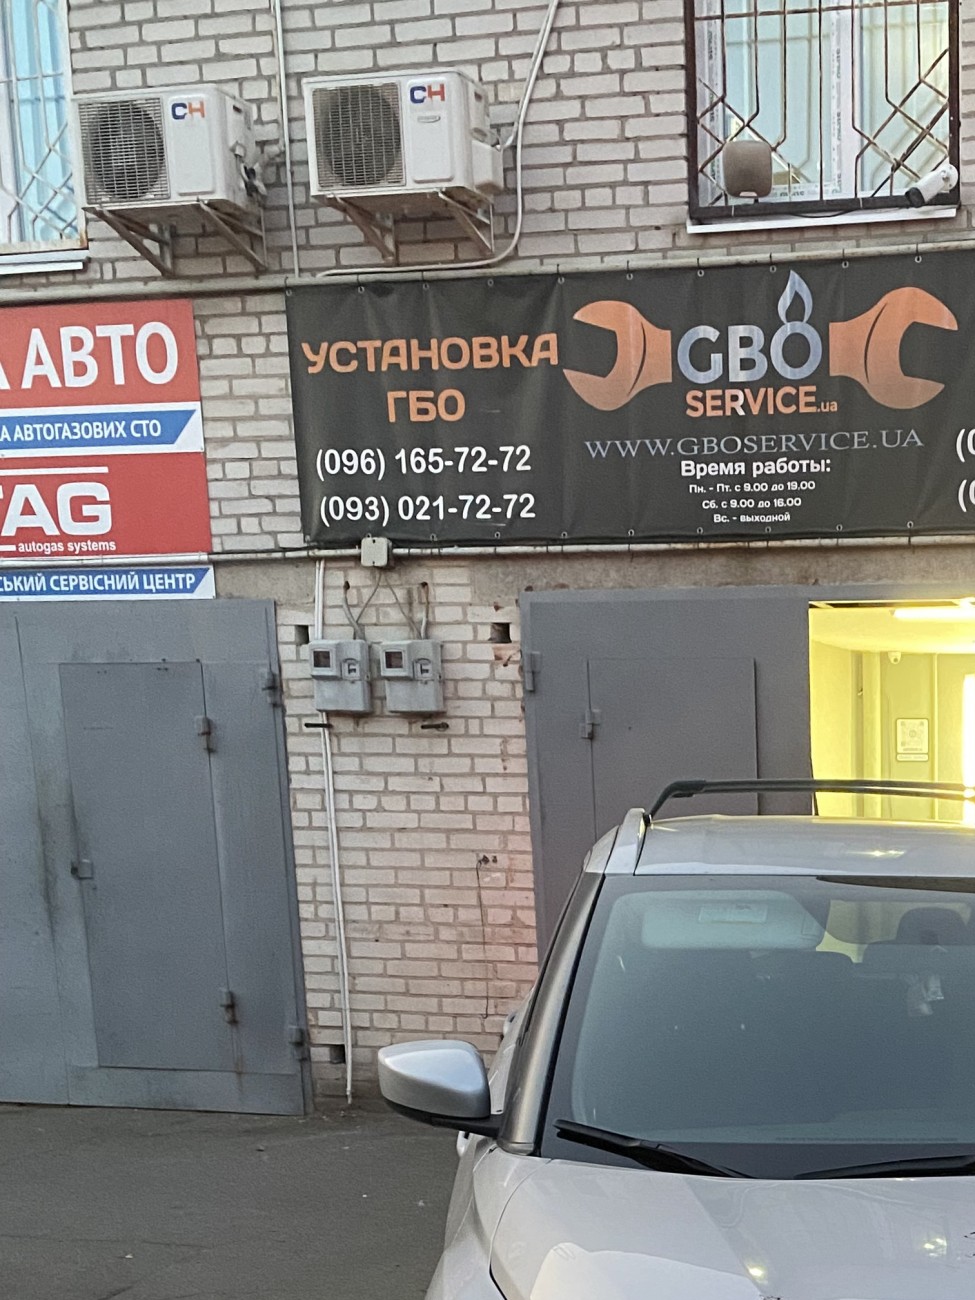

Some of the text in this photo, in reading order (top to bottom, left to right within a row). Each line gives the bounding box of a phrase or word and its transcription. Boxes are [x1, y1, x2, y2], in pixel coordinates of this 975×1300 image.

[410, 83, 445, 104] CH
[171, 100, 205, 120] CH
[21, 321, 179, 389] АВТО
[301, 333, 559, 374] УСТАНОВКА
[677, 320, 823, 384] GBO
[387, 388, 466, 423] ГБО
[14, 420, 127, 442] АВТОГАЗОВИХ
[130, 419, 162, 438] СТО
[585, 428, 924, 459] WWW.GBOSERVICE.UA
[316, 445, 532, 481] (096) 165-72-72
[681, 457, 831, 479] Время работы:
[689, 484, 707, 493] Пн.
[716, 483, 732, 492] Пт.
[743, 482, 768, 492] 9.00
[771, 483, 784, 492] до
[0, 481, 113, 537] AG
[320, 493, 536, 527] (093) 021-72-72
[702, 500, 718, 509] Сб.
[730, 499, 754, 508] 9.00
[757, 500, 771, 509] до
[740, 512, 791, 522] выходной
[18, 540, 116, 554] autogas systems
[50, 572, 139, 591] СЕРВІСНИЙ
[143, 573, 196, 592] ЦЕНТР
